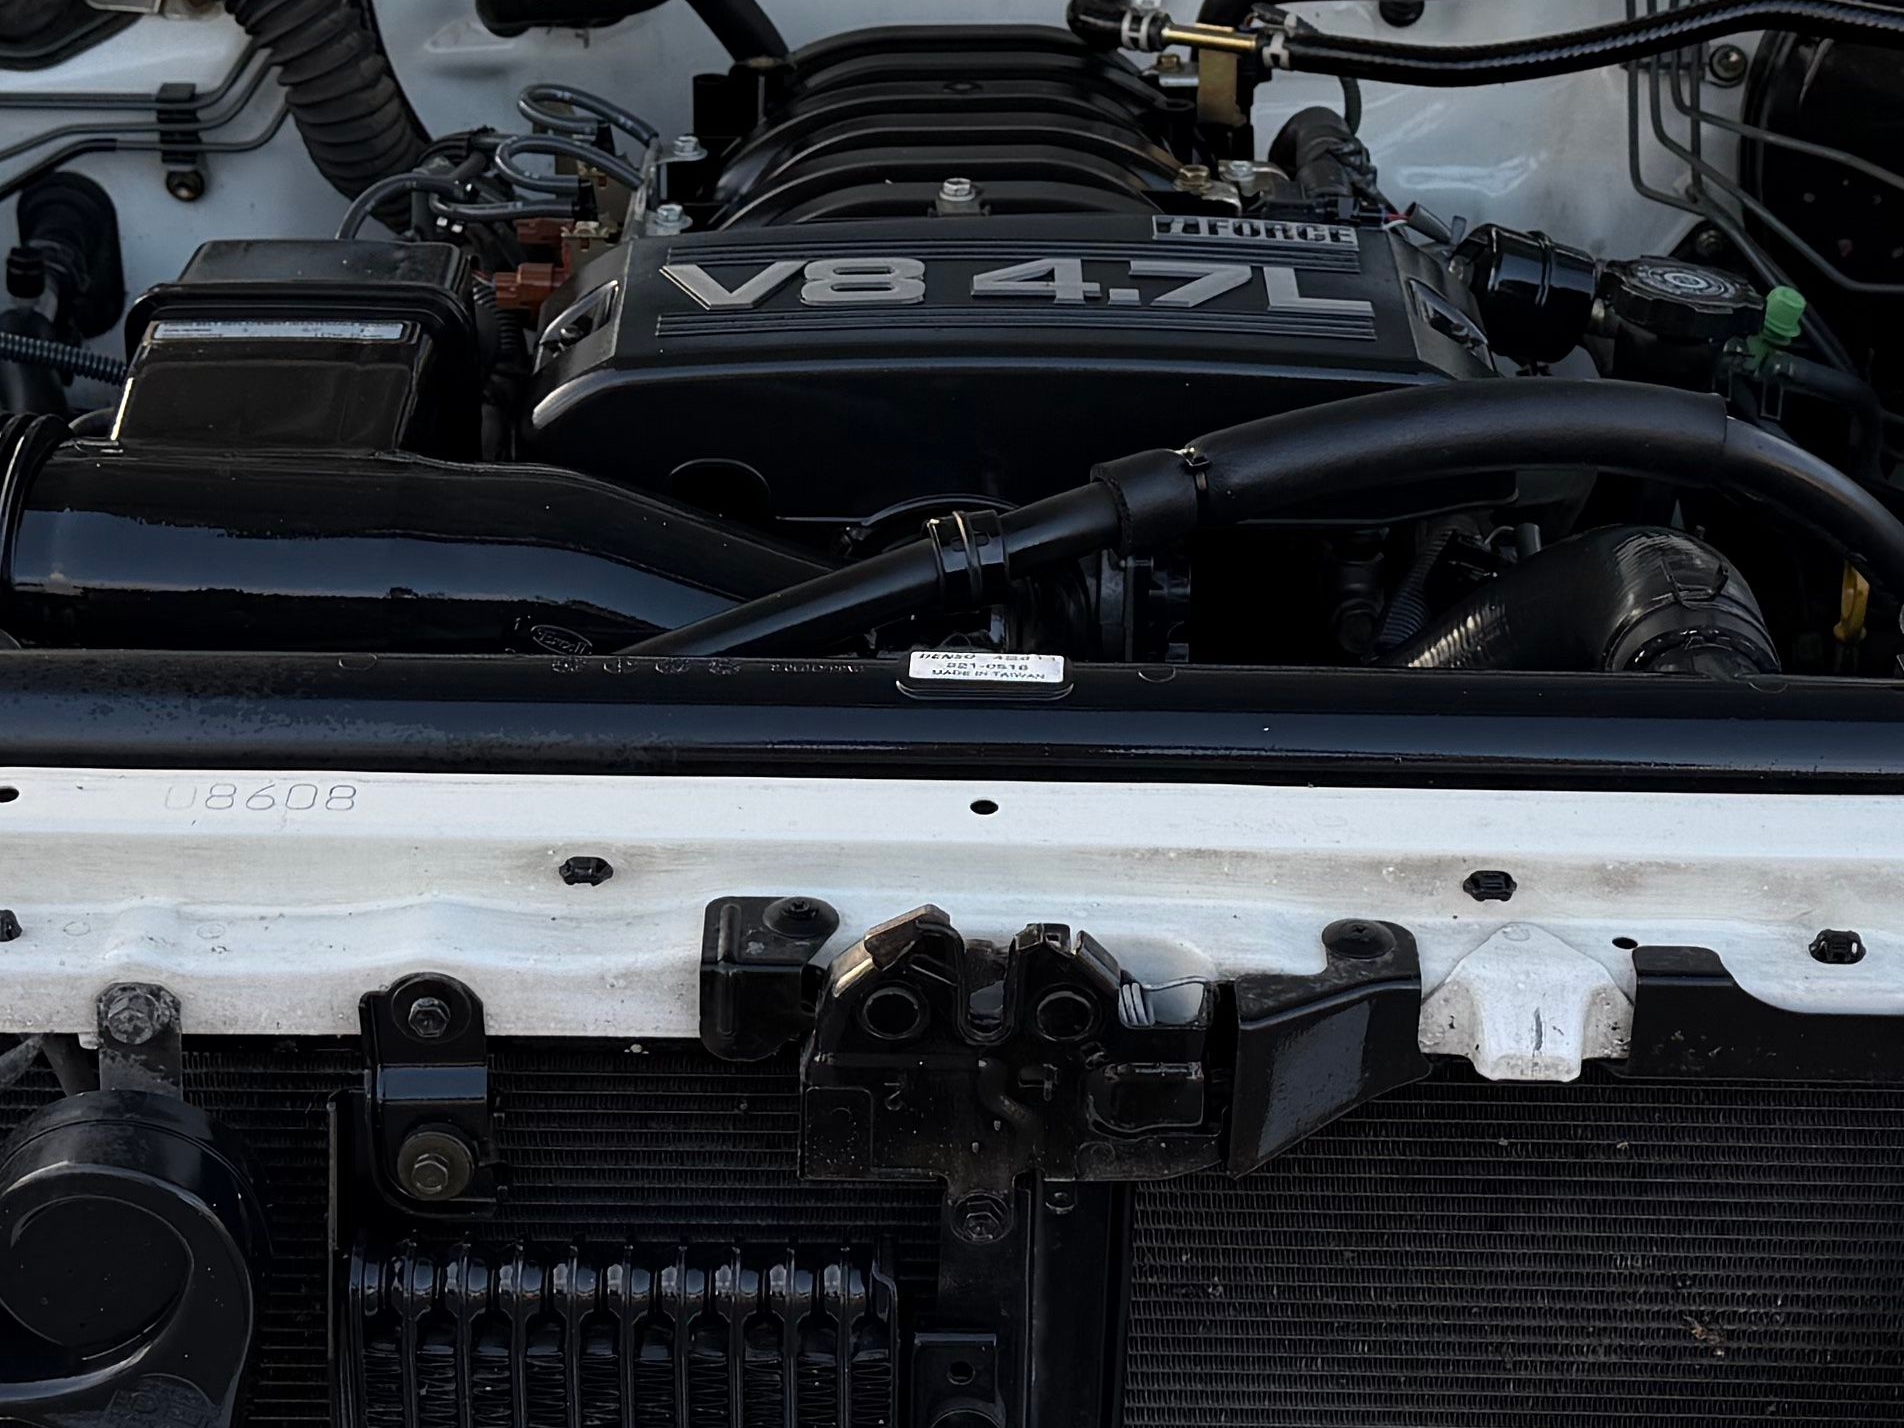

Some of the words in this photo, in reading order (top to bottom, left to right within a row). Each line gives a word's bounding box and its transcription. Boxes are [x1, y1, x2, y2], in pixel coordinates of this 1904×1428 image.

[658, 255, 927, 311] V8
[970, 256, 1376, 316] 4.7L
[931, 669, 970, 677] MADE
[992, 670, 1046, 680] TAIWAN
